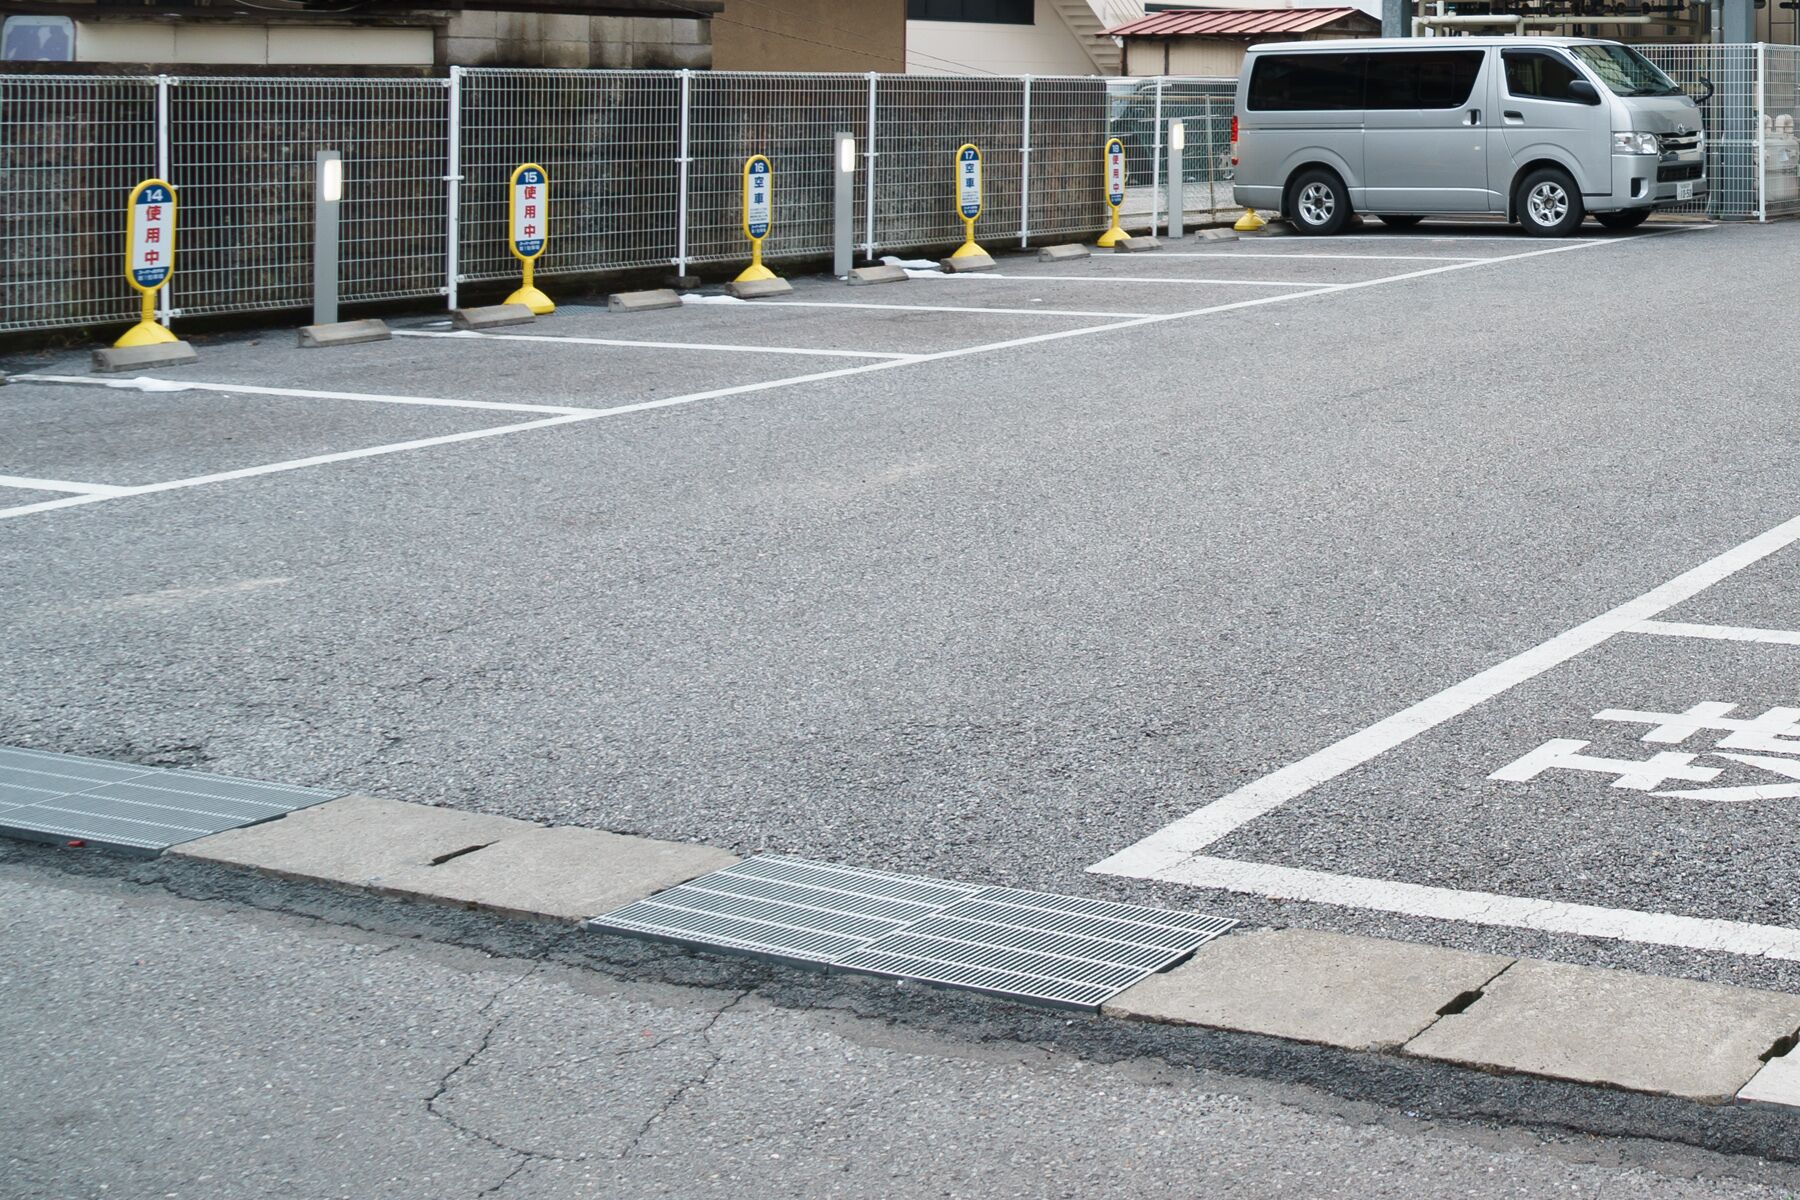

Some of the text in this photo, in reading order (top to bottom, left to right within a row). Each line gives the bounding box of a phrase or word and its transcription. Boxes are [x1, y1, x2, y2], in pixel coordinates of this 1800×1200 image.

[964, 150, 975, 160] 17
[754, 162, 764, 173] 16
[524, 171, 538, 183] 15
[145, 189, 164, 202] 14
[524, 185, 536, 238] 使用中
[144, 205, 162, 266] 使用中
